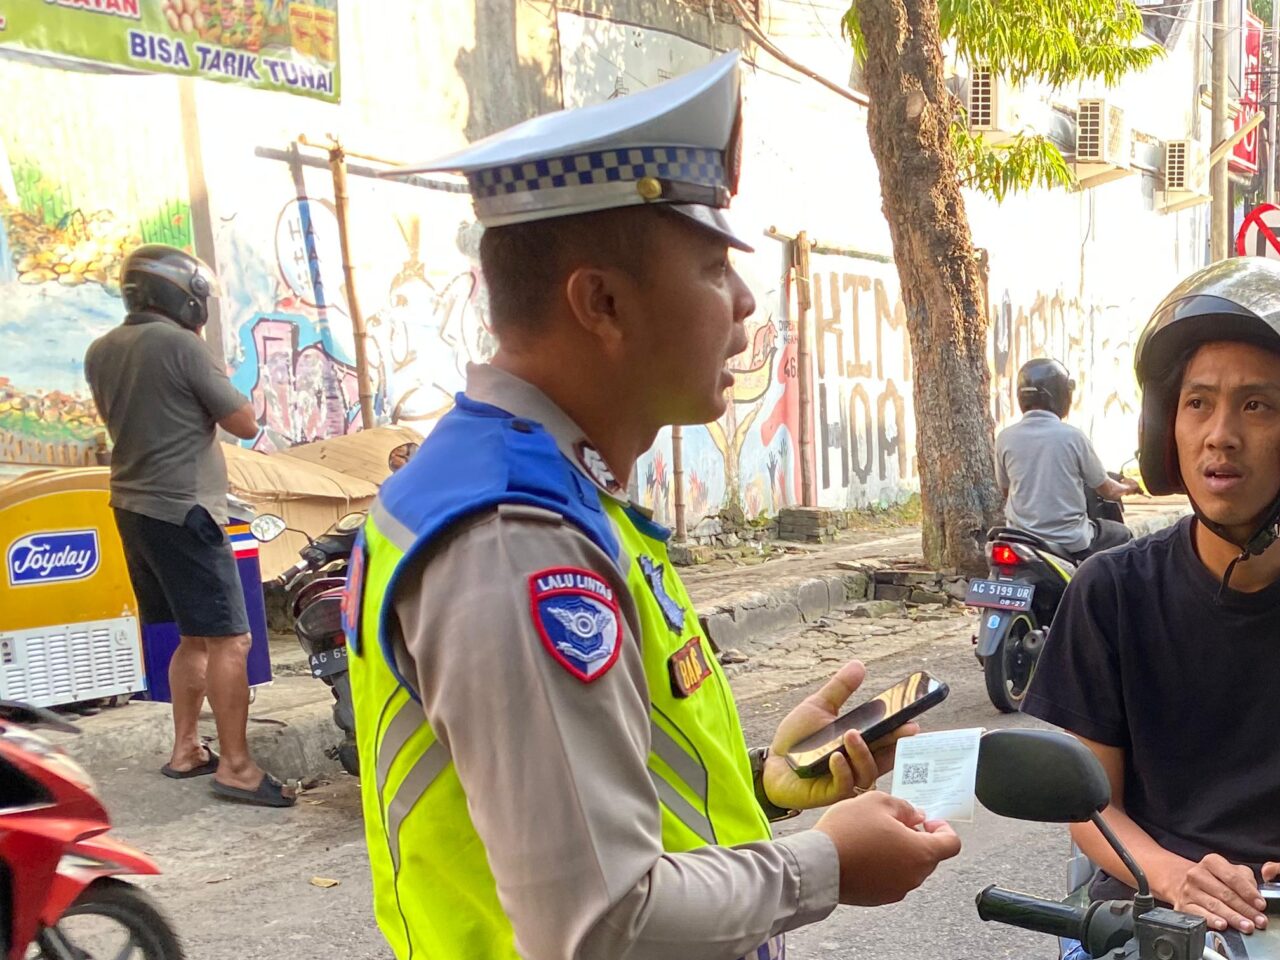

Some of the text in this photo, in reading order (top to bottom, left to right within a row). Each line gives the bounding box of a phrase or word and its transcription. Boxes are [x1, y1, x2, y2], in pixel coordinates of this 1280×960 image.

[130, 32, 333, 93] BISA TARIK TUNAI
[13, 543, 92, 577] Joyday
[537, 573, 613, 601] LALU LINTAS
[972, 584, 1030, 598] AG 5199 UR
[311, 652, 328, 666] AG
